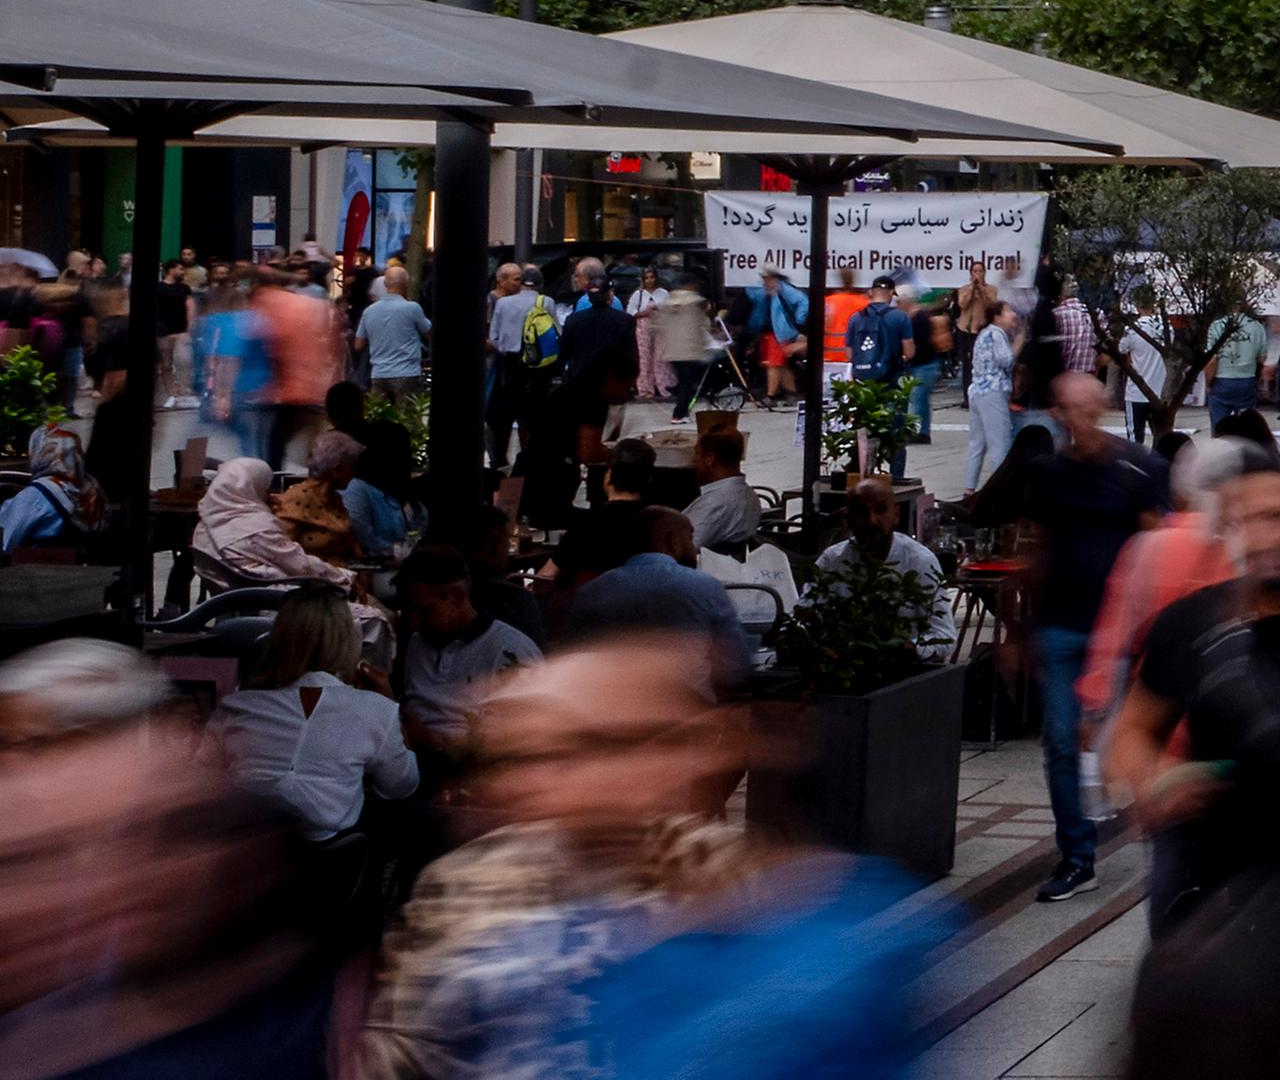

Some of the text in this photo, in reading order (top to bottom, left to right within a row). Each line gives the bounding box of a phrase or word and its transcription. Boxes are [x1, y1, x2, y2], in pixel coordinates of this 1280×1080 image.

[834, 202, 871, 232] آزاد
[880, 207, 949, 234] سیاسی
[960, 208, 1024, 233] زندانی
[870, 250, 953, 271] Prisoners
